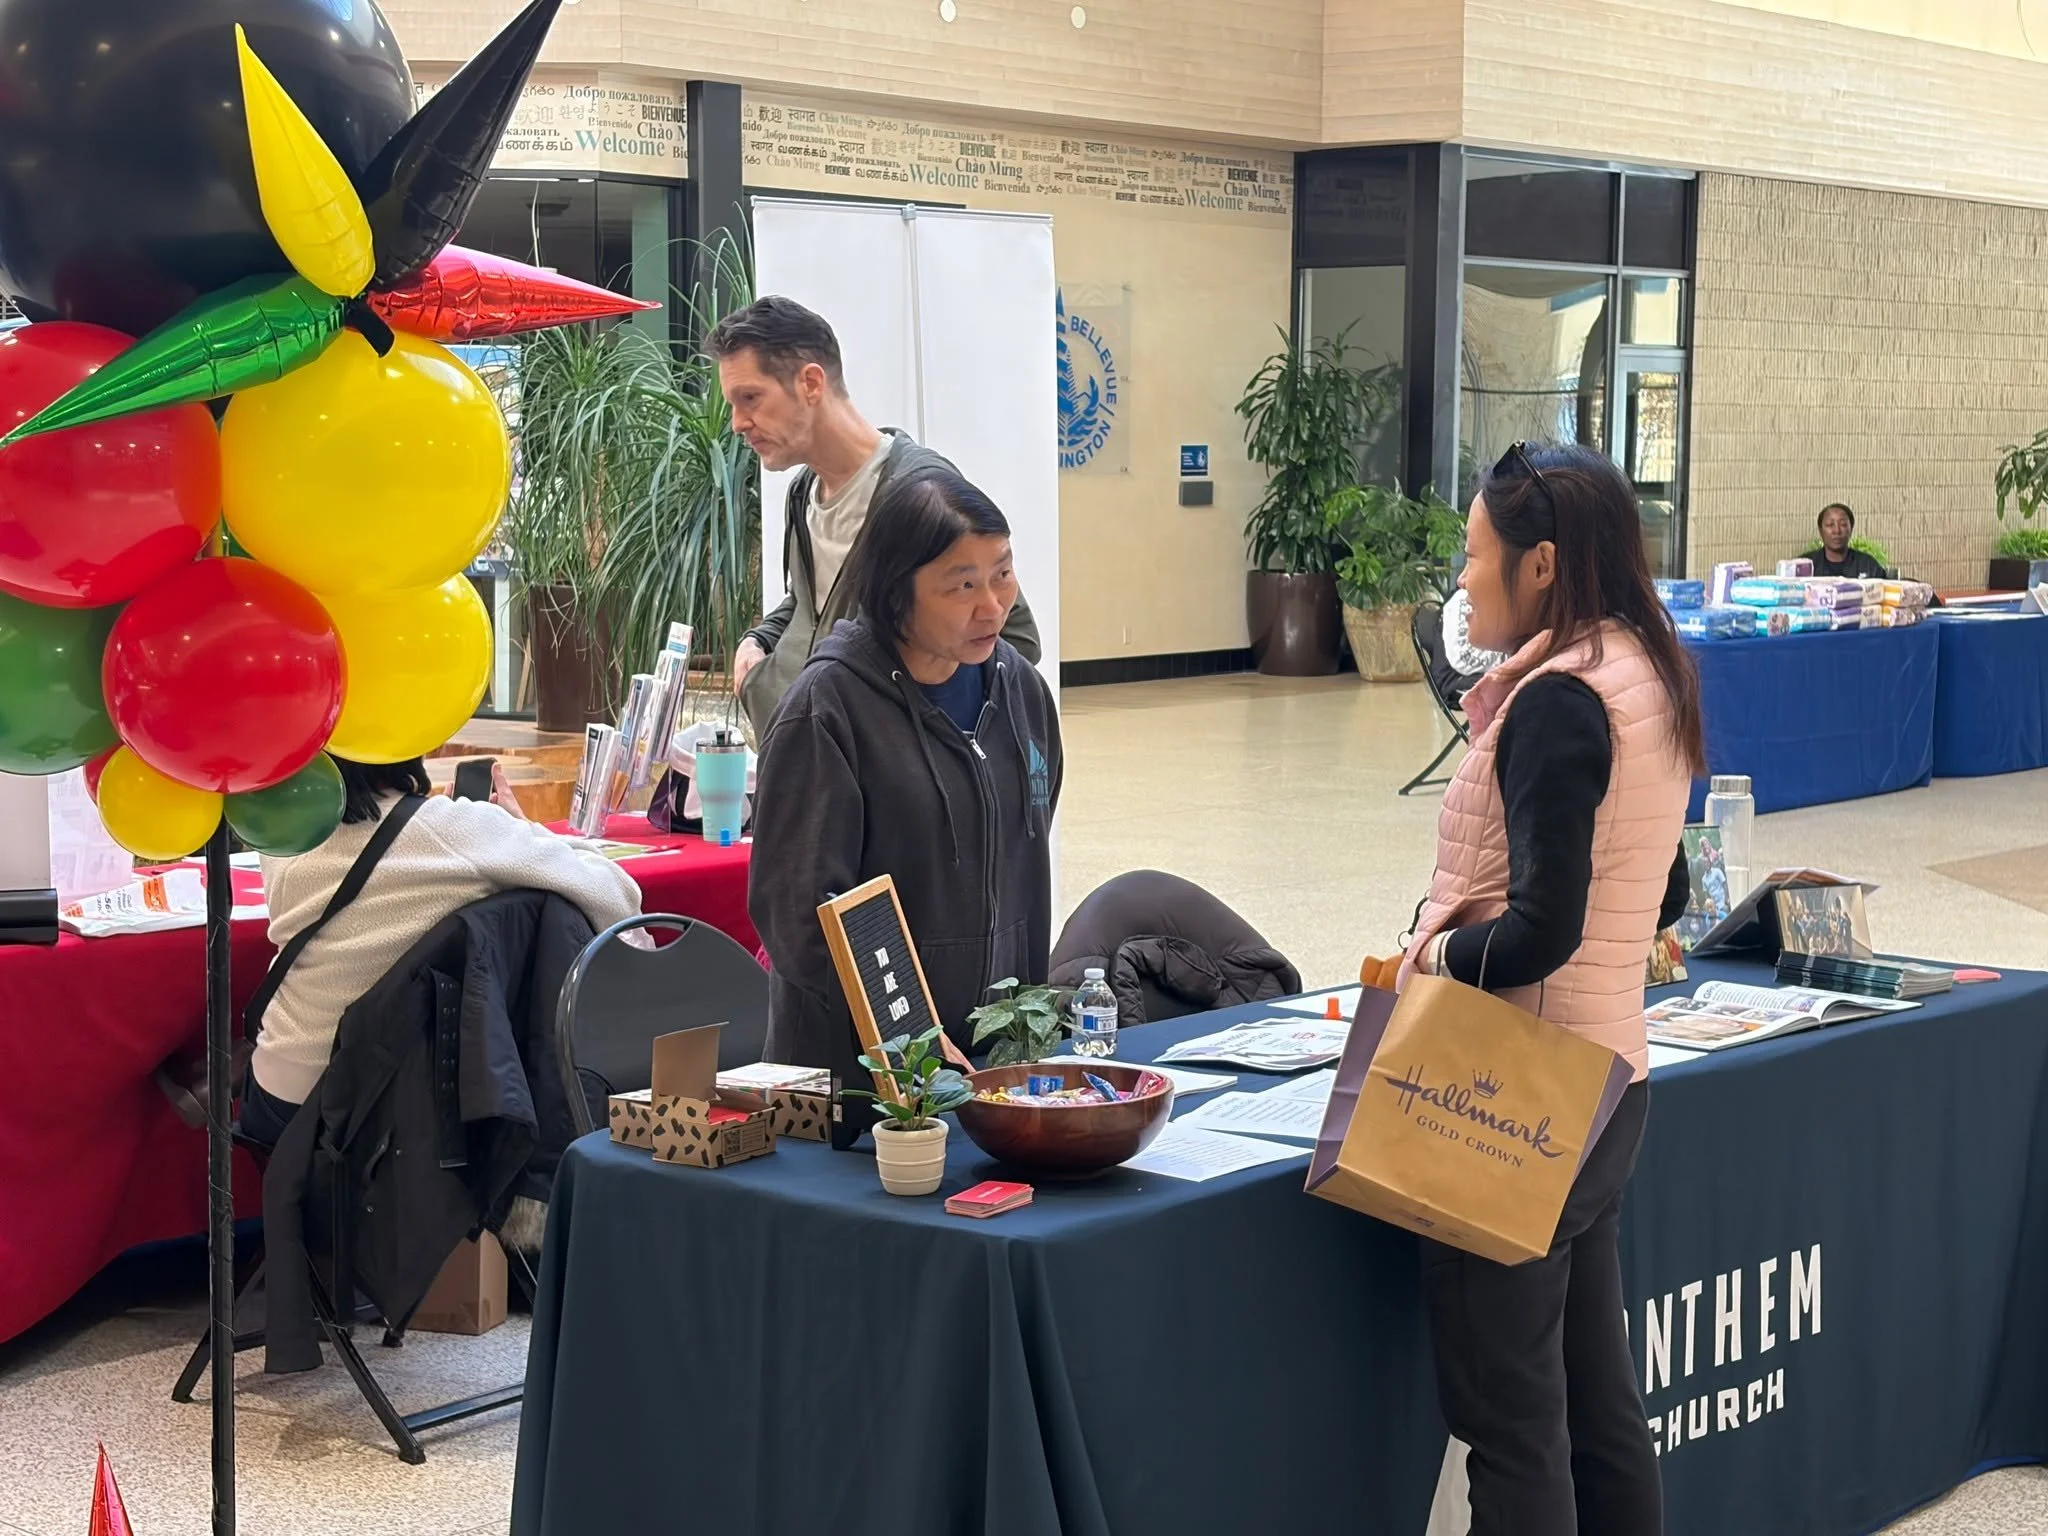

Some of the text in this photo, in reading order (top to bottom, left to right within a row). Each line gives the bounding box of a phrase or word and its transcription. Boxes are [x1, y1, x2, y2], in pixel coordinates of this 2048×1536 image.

[563, 85, 606, 103] Добро
[609, 89, 673, 106] пожаловать
[588, 101, 637, 118] ようこそ
[641, 104, 686, 123] BIENVENUE
[588, 116, 633, 129] Bienvenido
[636, 121, 674, 141] Chào
[902, 122, 986, 142] Добро пожаловать
[575, 129, 666, 157] Welcome
[959, 141, 997, 159] BIENVENUE
[955, 157, 986, 175] Chào
[1022, 150, 1064, 164] Bienvenido
[908, 163, 979, 190] Welcome
[984, 179, 1031, 194] Bienvenida
[1185, 188, 1244, 211] Welcome
[1223, 181, 1249, 197] Chào
[1070, 314, 1118, 405] BELLEVUE
[1059, 419, 1112, 468] INGTON
[883, 971, 899, 994] ARE
[888, 995, 910, 1022] LOVED
[1384, 1063, 1564, 1159] Hallmark
[1416, 1114, 1525, 1169] GOLD CROWN
[1624, 1243, 1822, 1394] NTHEM
[1648, 1368, 1785, 1457] CHURCH
